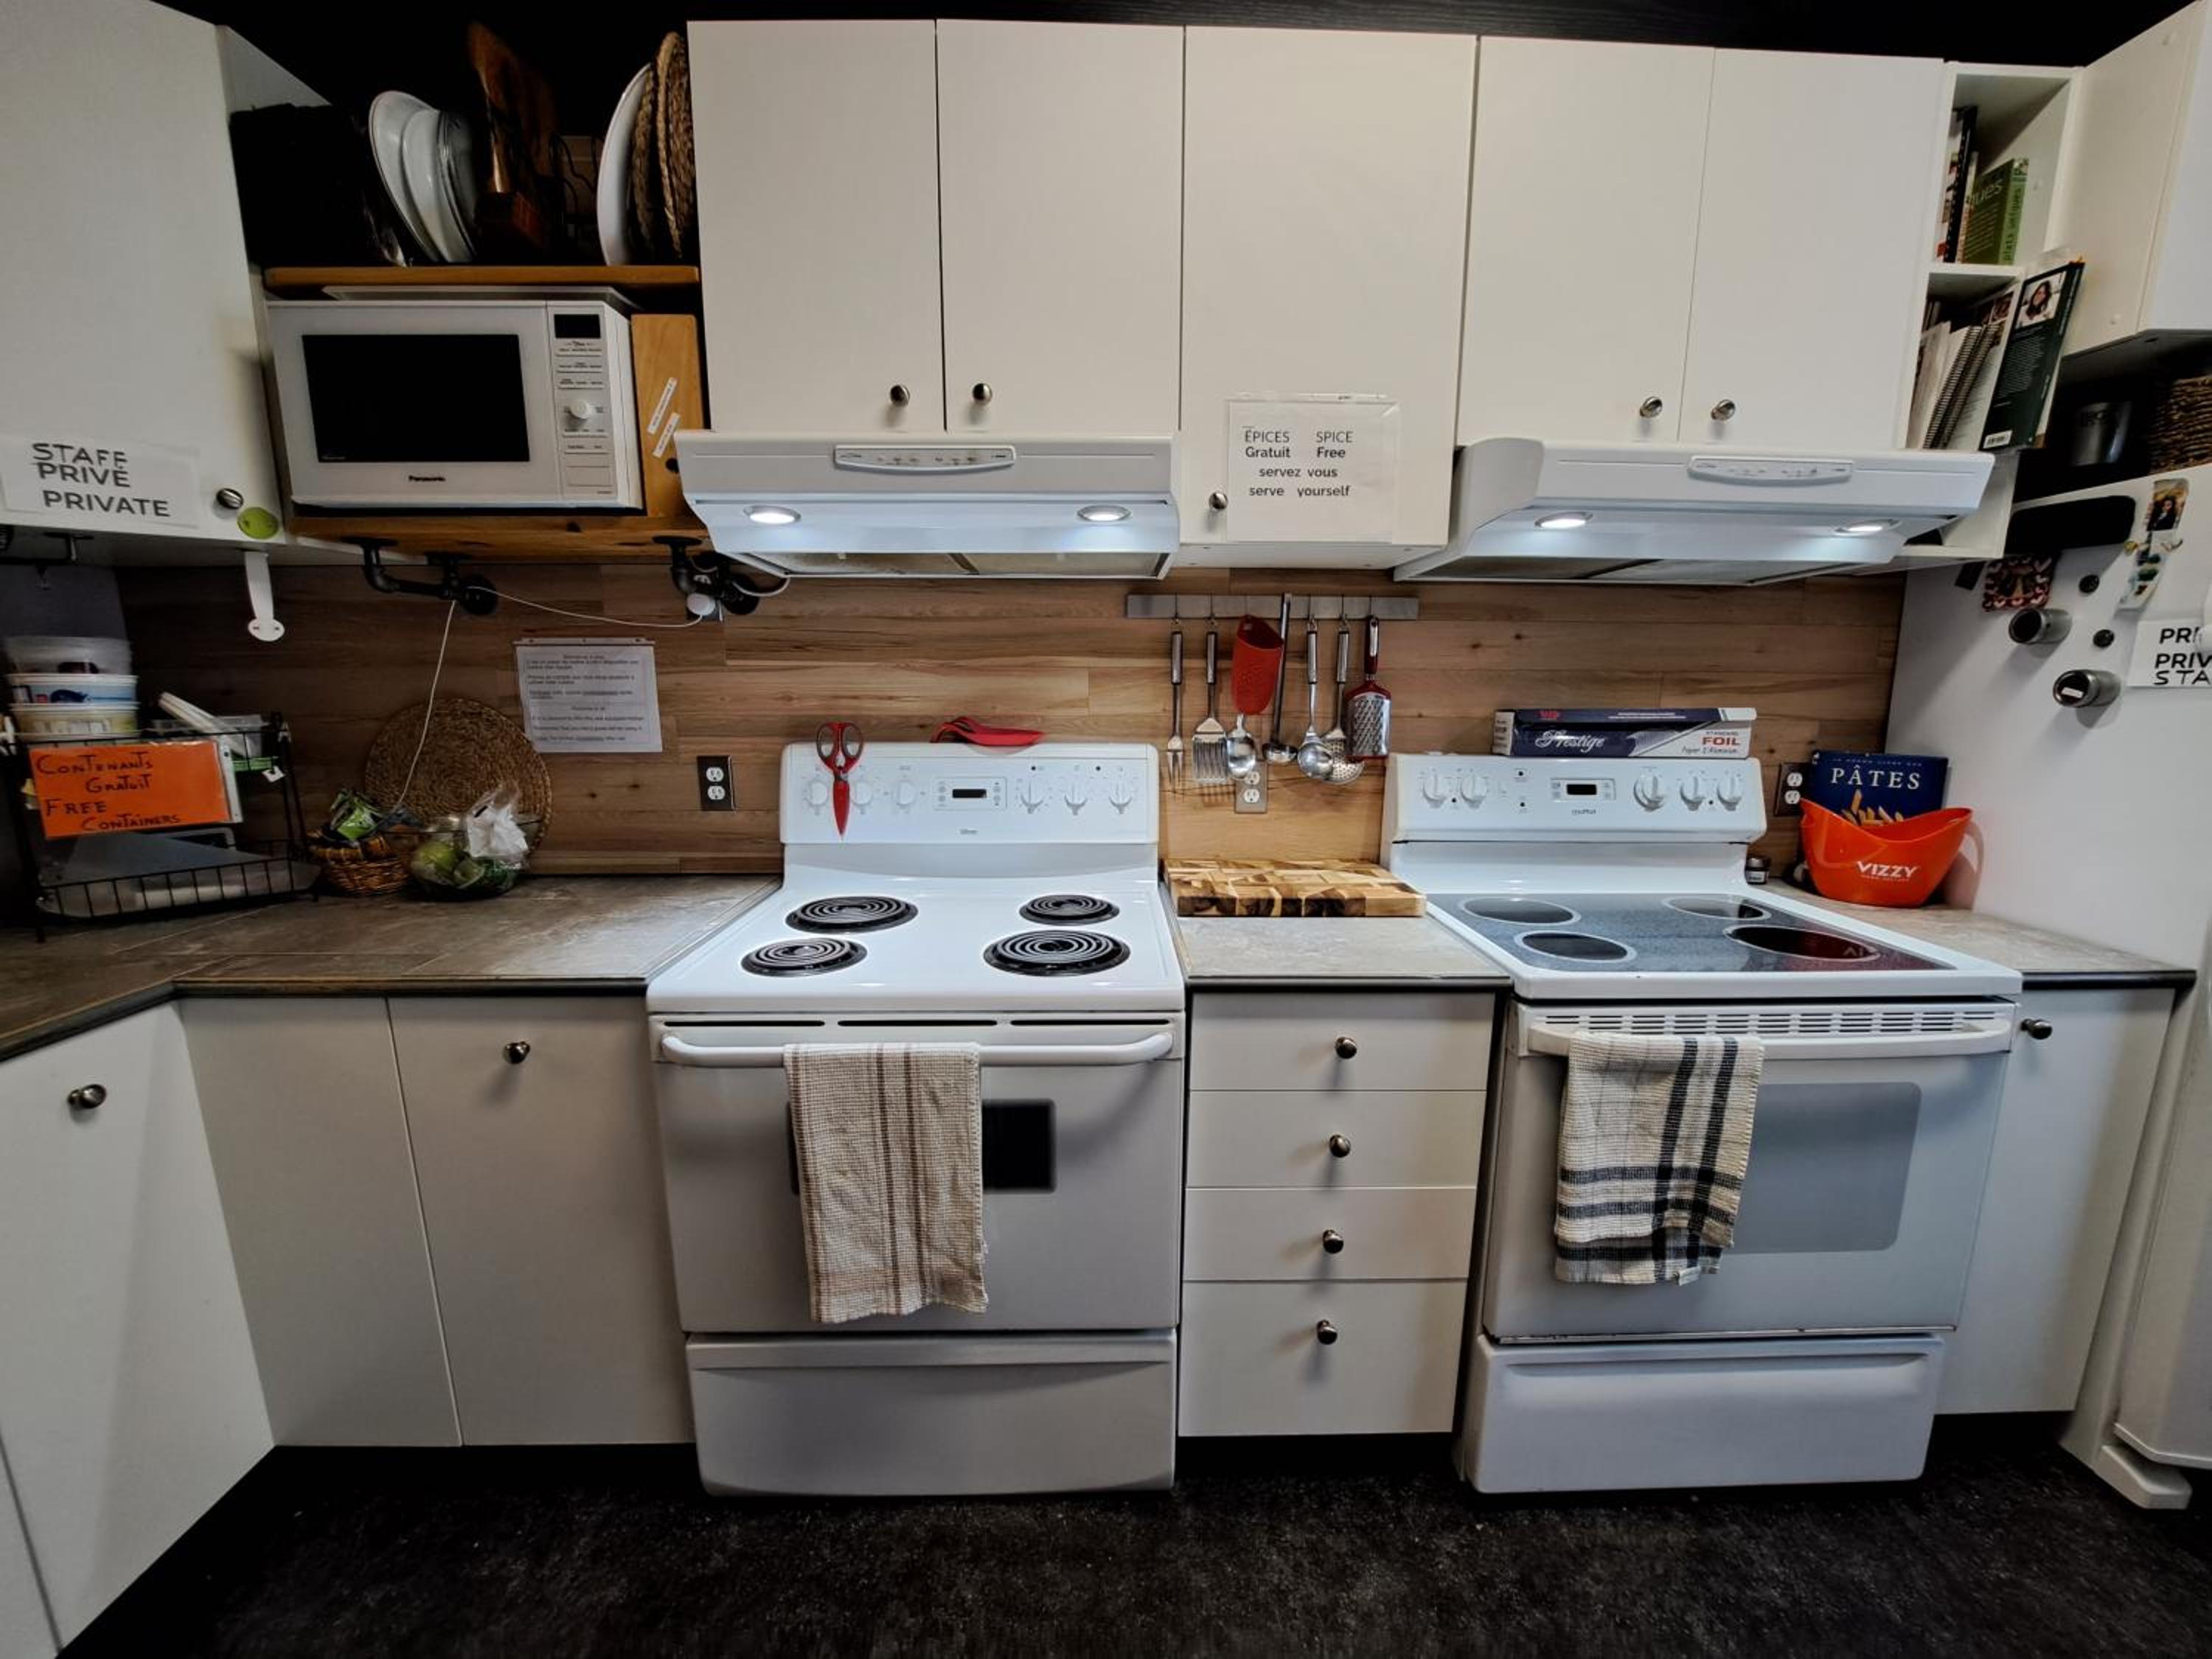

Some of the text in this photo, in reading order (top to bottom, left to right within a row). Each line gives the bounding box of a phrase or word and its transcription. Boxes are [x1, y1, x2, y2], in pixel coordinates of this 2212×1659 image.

[1315, 431, 1354, 443] SPICE
[1245, 446, 1346, 459] Gratuit Free
[1259, 467, 1338, 478] servez vous
[1249, 484, 1351, 498] serve yourself
[43, 490, 171, 517] PRIVATE
[1702, 737, 1741, 745] FOIL
[1831, 765, 1921, 790] PÂTES
[46, 799, 107, 816] FREE
[1857, 860, 1919, 878] VIZZY
